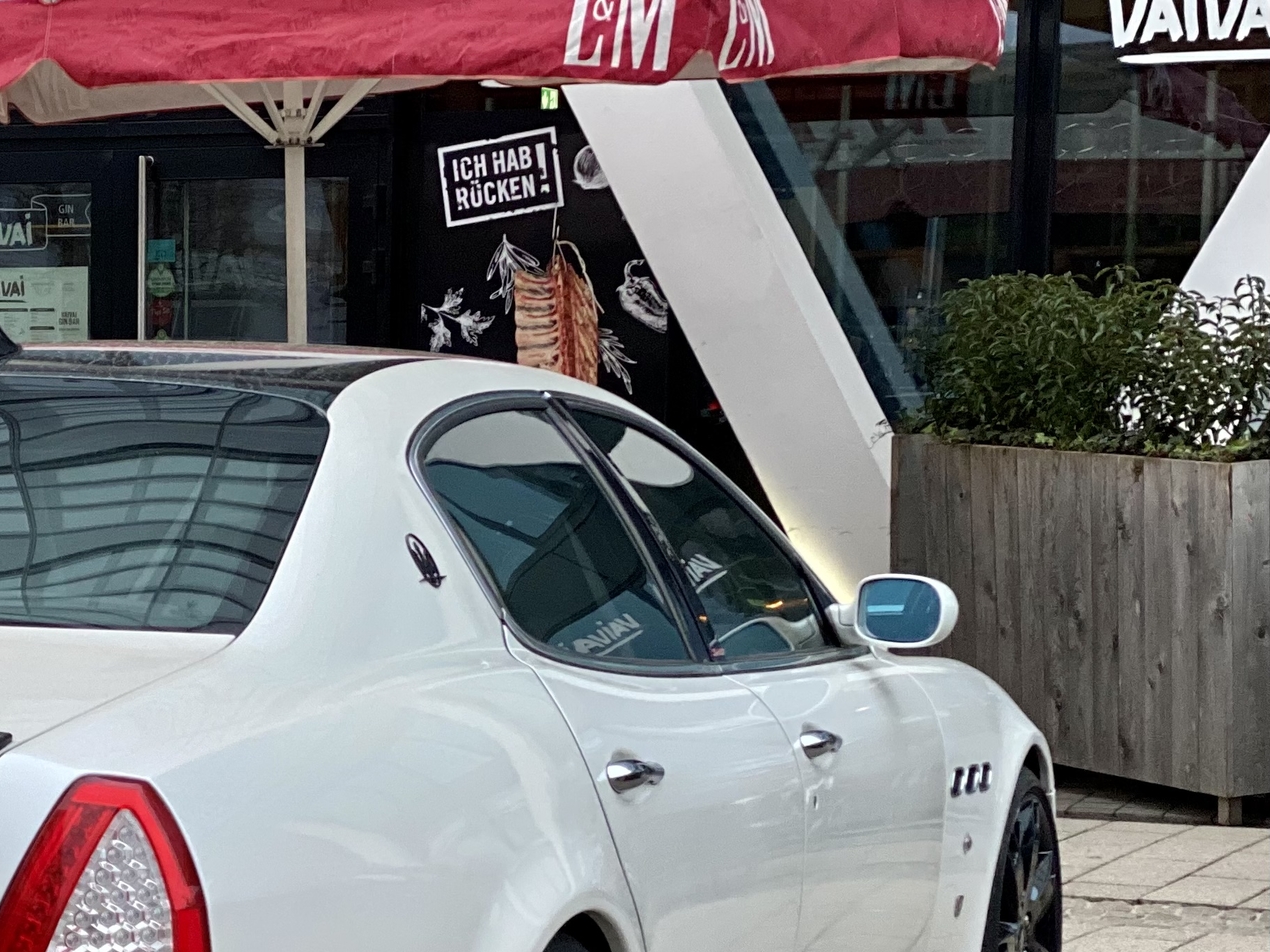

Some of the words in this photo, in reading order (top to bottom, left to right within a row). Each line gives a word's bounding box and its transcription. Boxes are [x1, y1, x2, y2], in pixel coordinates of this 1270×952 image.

[452, 153, 487, 182] ICH
[492, 145, 532, 175] HAB
[455, 174, 536, 211] RÜCKEN
[58, 204, 74, 214] GIN
[57, 218, 75, 227] BAR
